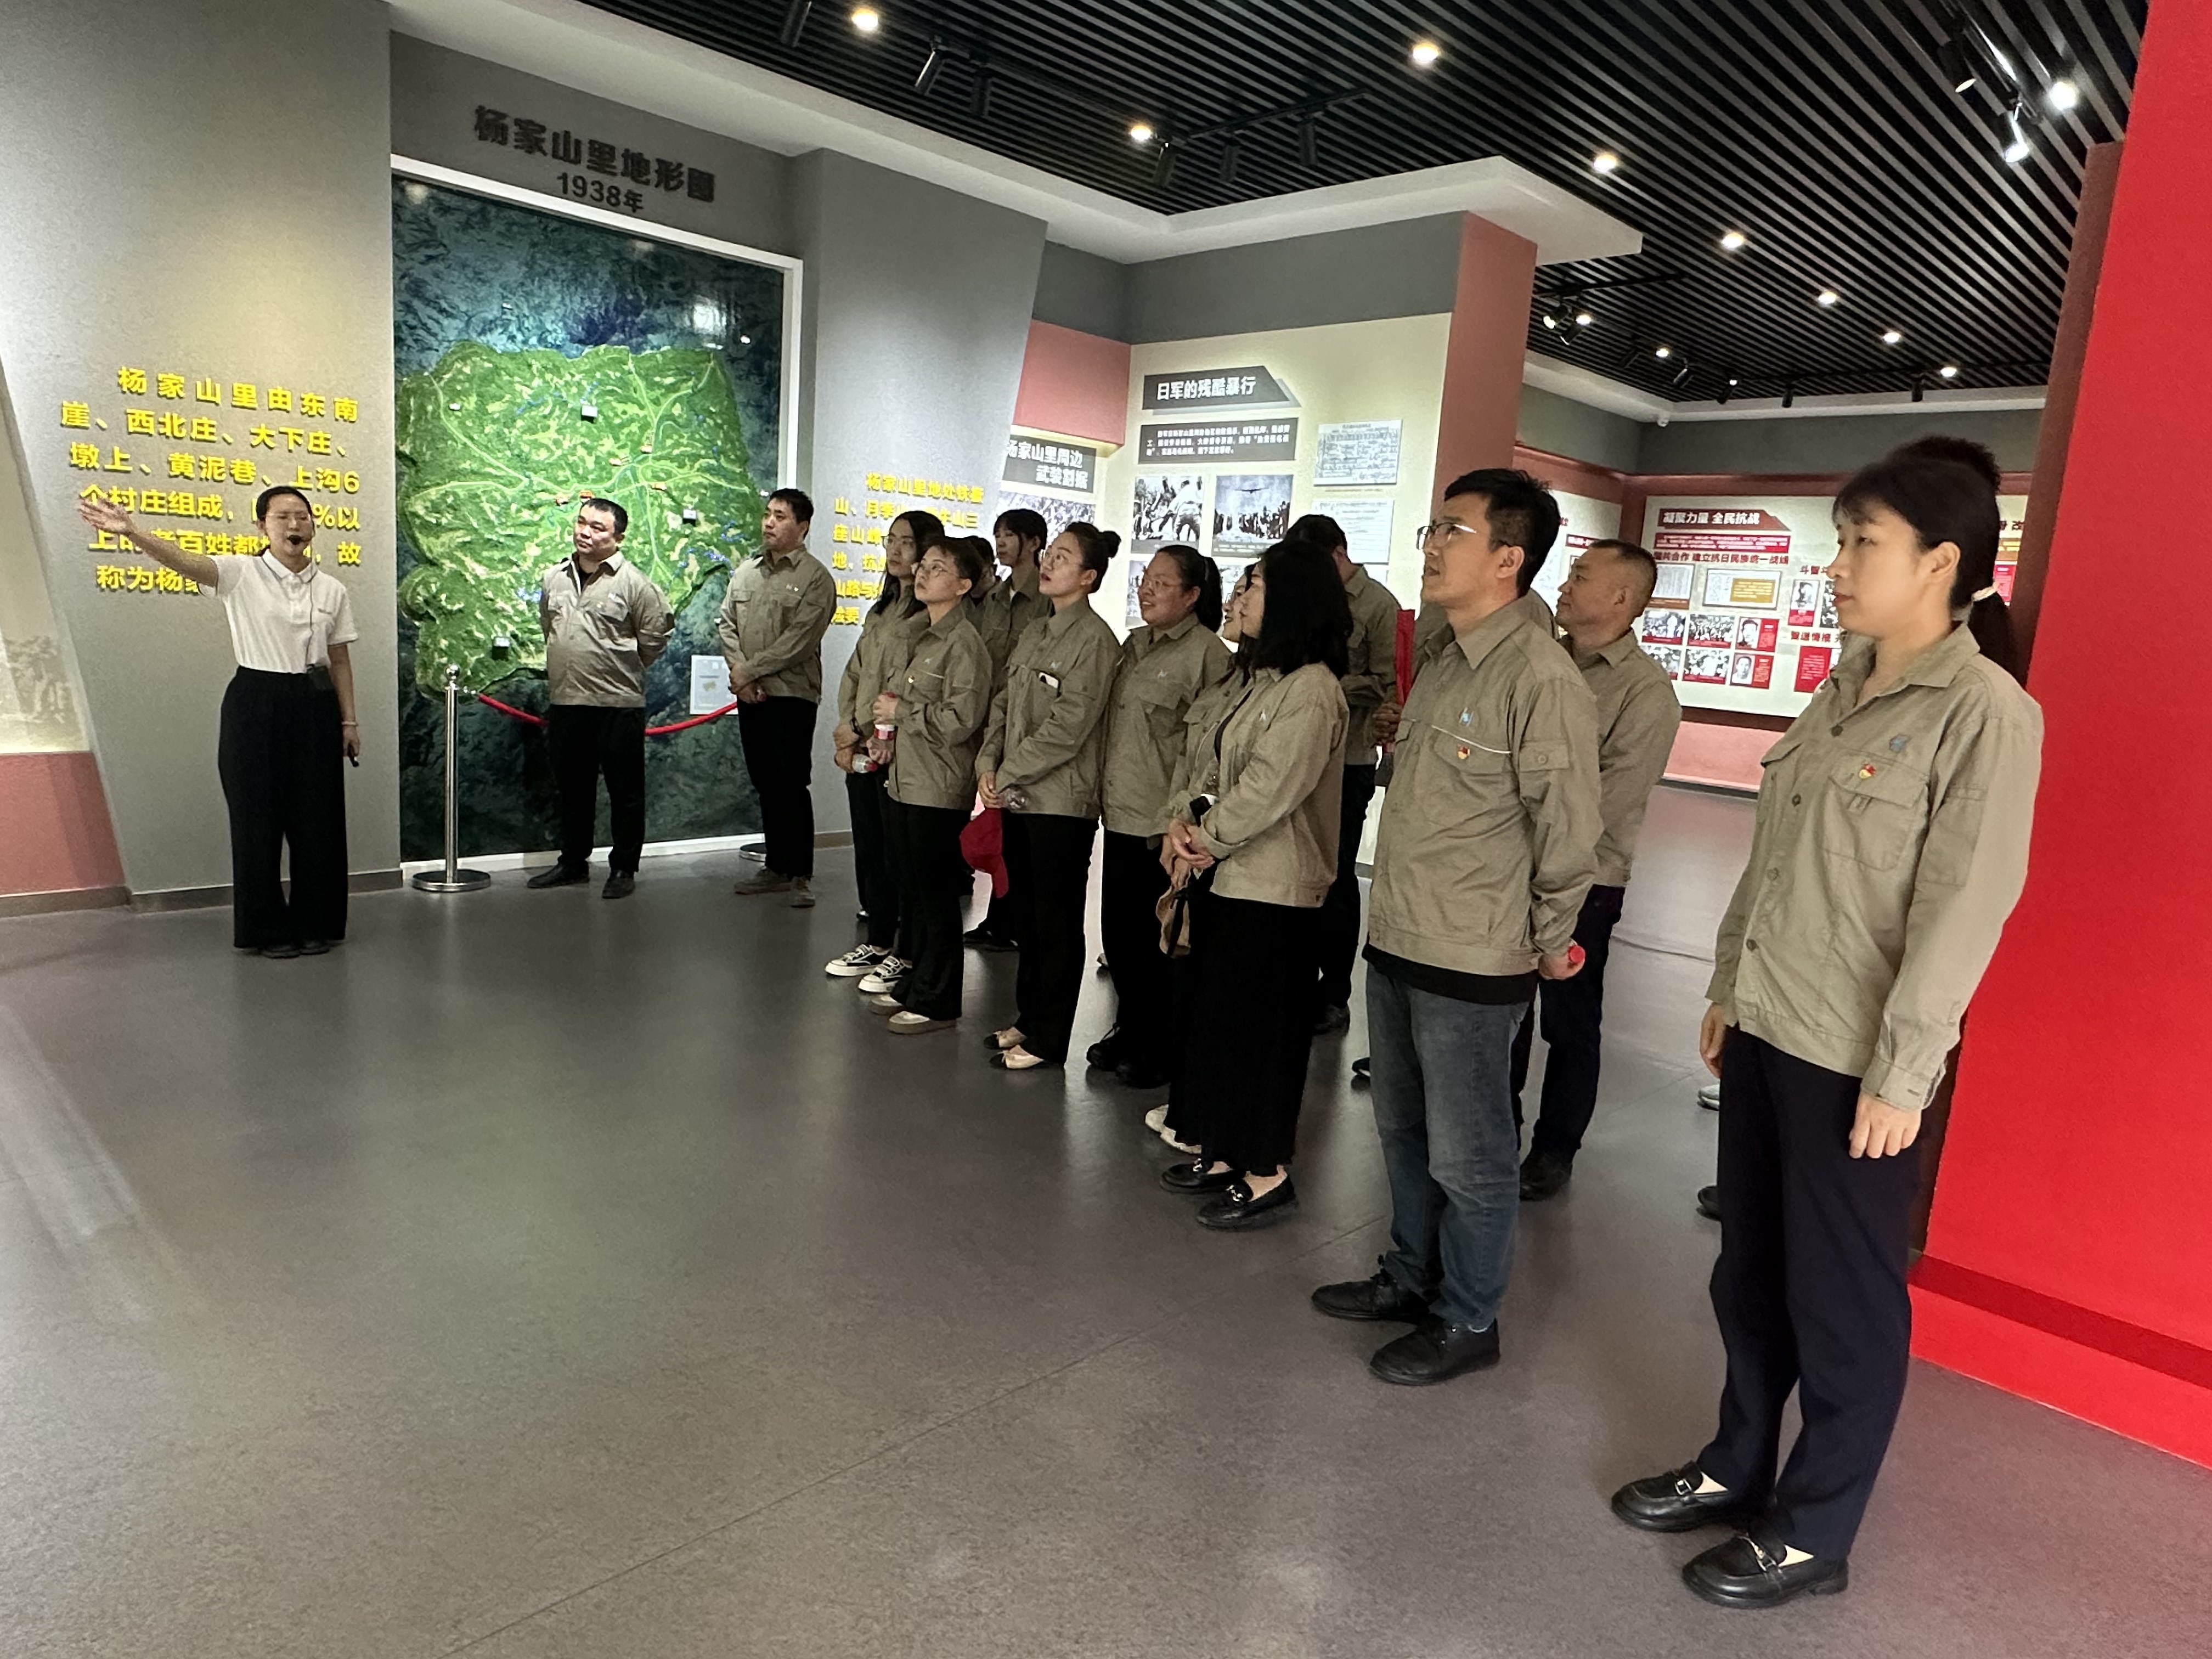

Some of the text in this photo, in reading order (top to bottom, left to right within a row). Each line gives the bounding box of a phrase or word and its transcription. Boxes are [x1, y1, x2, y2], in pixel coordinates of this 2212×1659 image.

[474, 105, 715, 202] 杨家山里地形图
[556, 172, 644, 212] 1938年
[117, 366, 358, 421] 杨家山里由东南
[1156, 376, 1256, 400] 日军的残酷暴行
[61, 400, 347, 456] 崖、西北庄、大下庄、
[70, 442, 359, 493] 墩上、黄泥巷、上沟6
[1006, 439, 1083, 469] 杨家山里周边
[1036, 465, 1088, 489] 武装割据
[1662, 512, 1760, 524] 凝聚力量 全民抗战
